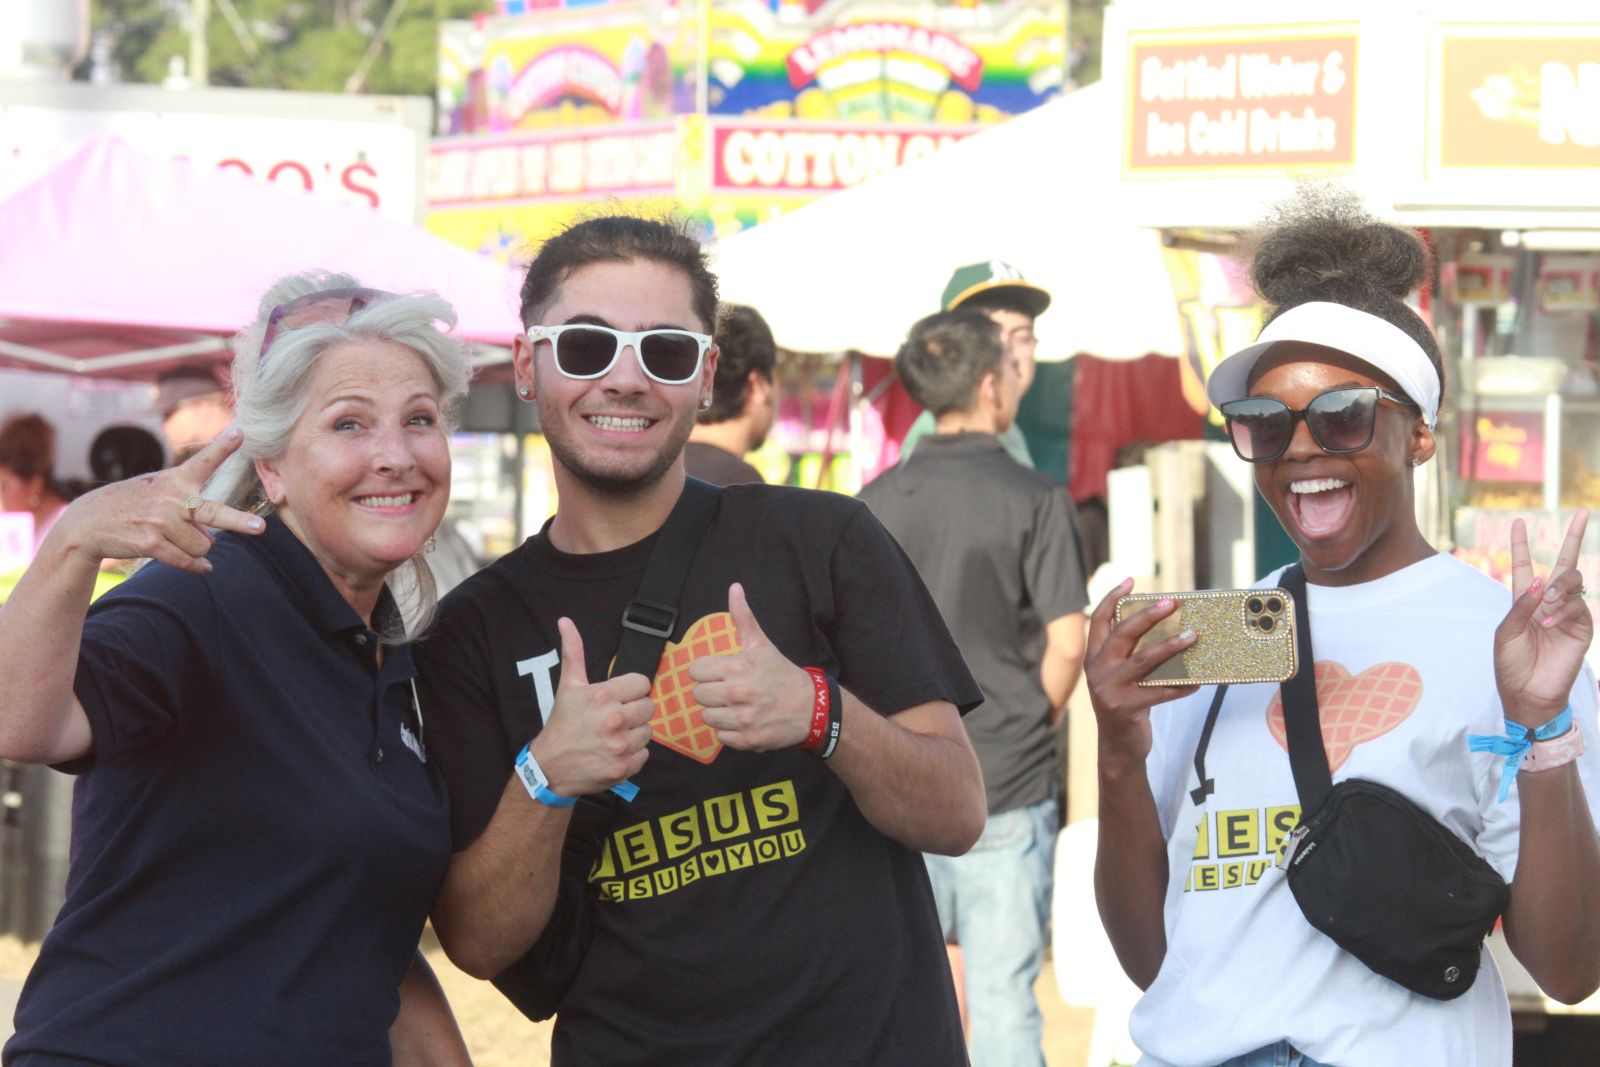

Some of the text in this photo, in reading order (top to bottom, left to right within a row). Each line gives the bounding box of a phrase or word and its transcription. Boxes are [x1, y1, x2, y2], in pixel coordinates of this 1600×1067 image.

[794, 26, 973, 76] LEMONADE
[724, 132, 898, 187] COTTON
[590, 784, 795, 878] ESUS
[602, 831, 804, 903] ESUS YOU
[1186, 861, 1269, 889] ESU
